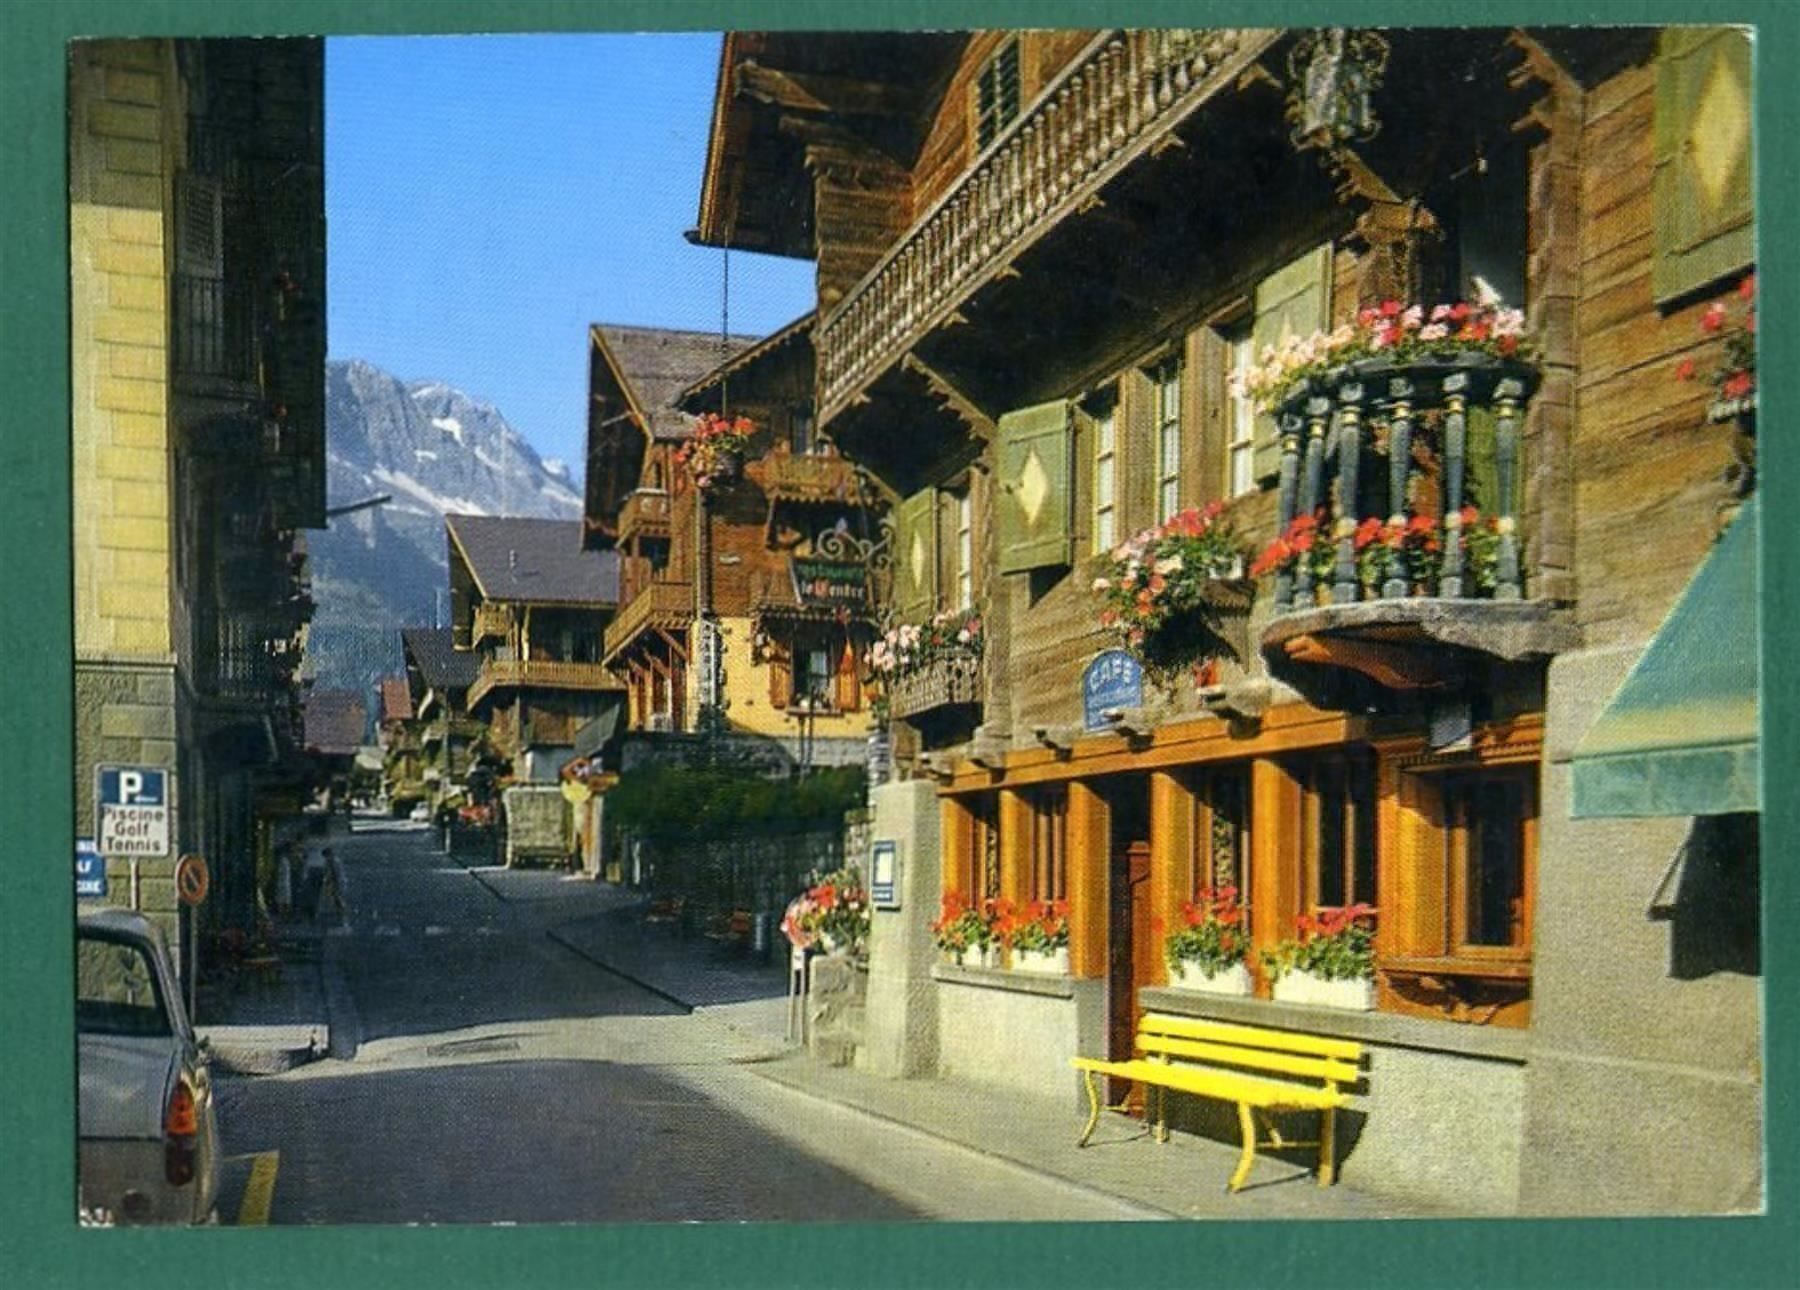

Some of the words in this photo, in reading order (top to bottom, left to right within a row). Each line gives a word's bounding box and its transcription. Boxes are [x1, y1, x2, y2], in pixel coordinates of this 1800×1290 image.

[119, 771, 142, 804] P
[104, 806, 163, 822] Piscine
[115, 821, 149, 835] Golf
[106, 836, 161, 851] Tennis
